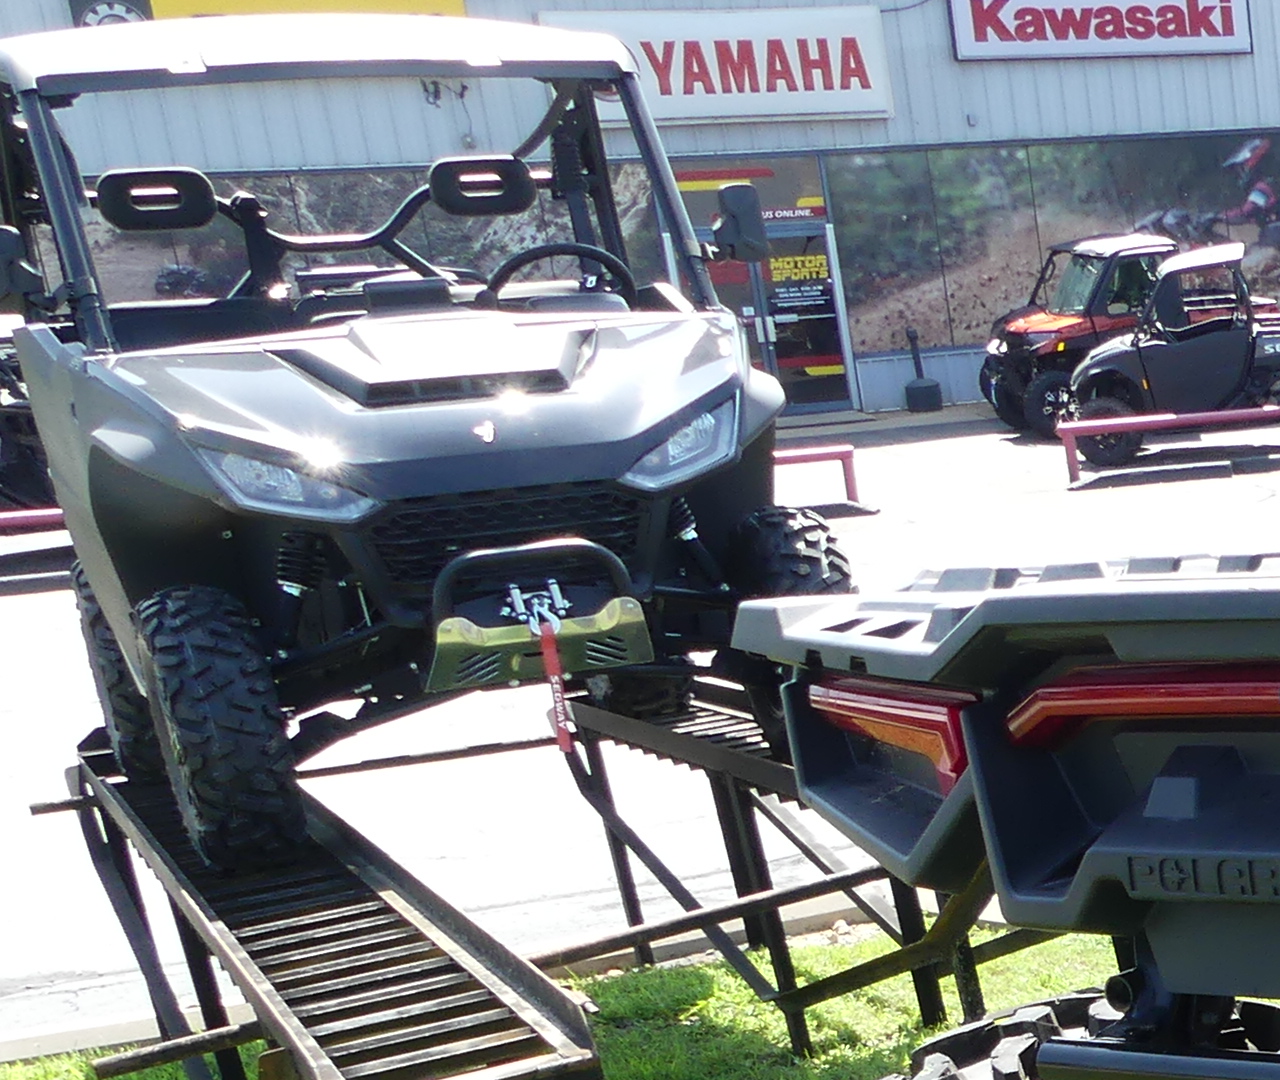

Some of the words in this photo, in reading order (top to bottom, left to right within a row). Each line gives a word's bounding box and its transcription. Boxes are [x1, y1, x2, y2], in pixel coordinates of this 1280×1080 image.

[970, 0, 1235, 43] Kawasaki
[639, 36, 872, 96] YAMAHA
[774, 208, 814, 219] ONLINE.
[769, 254, 827, 270] MOTOR
[772, 267, 829, 281] SPORTS
[550, 674, 568, 730] SEGWAY
